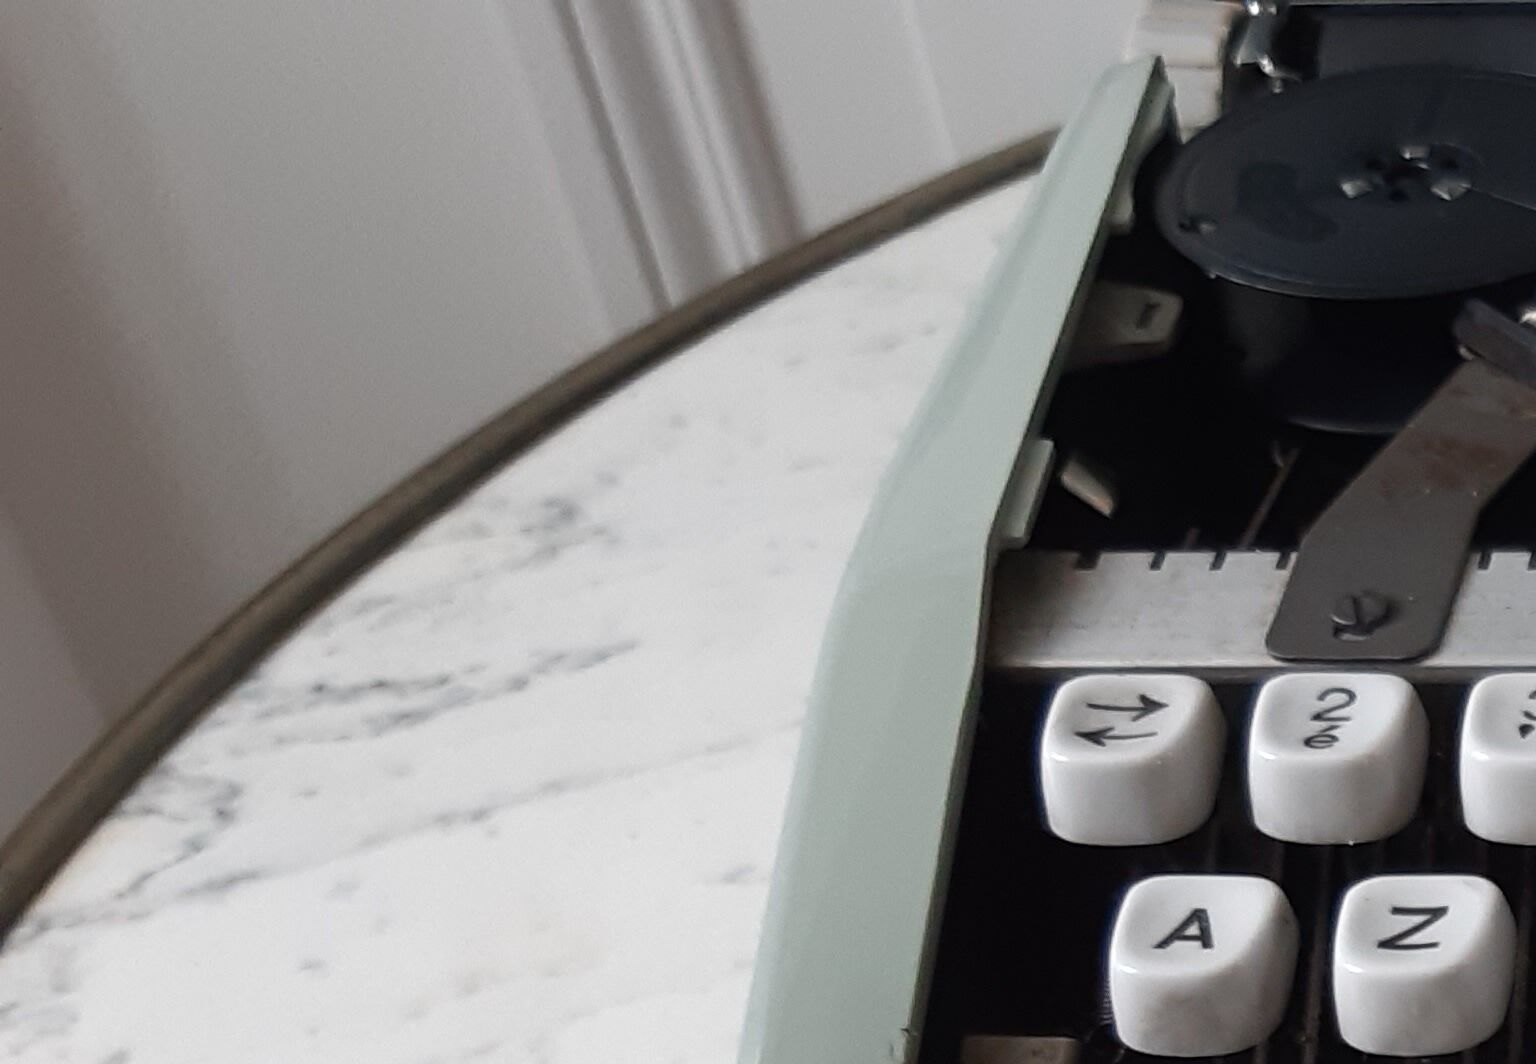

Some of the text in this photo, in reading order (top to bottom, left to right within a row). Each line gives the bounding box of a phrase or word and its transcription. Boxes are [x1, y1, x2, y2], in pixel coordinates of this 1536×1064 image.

[1310, 688, 1356, 722] 2
[1153, 908, 1213, 949] A
[1377, 906, 1448, 950] Z
